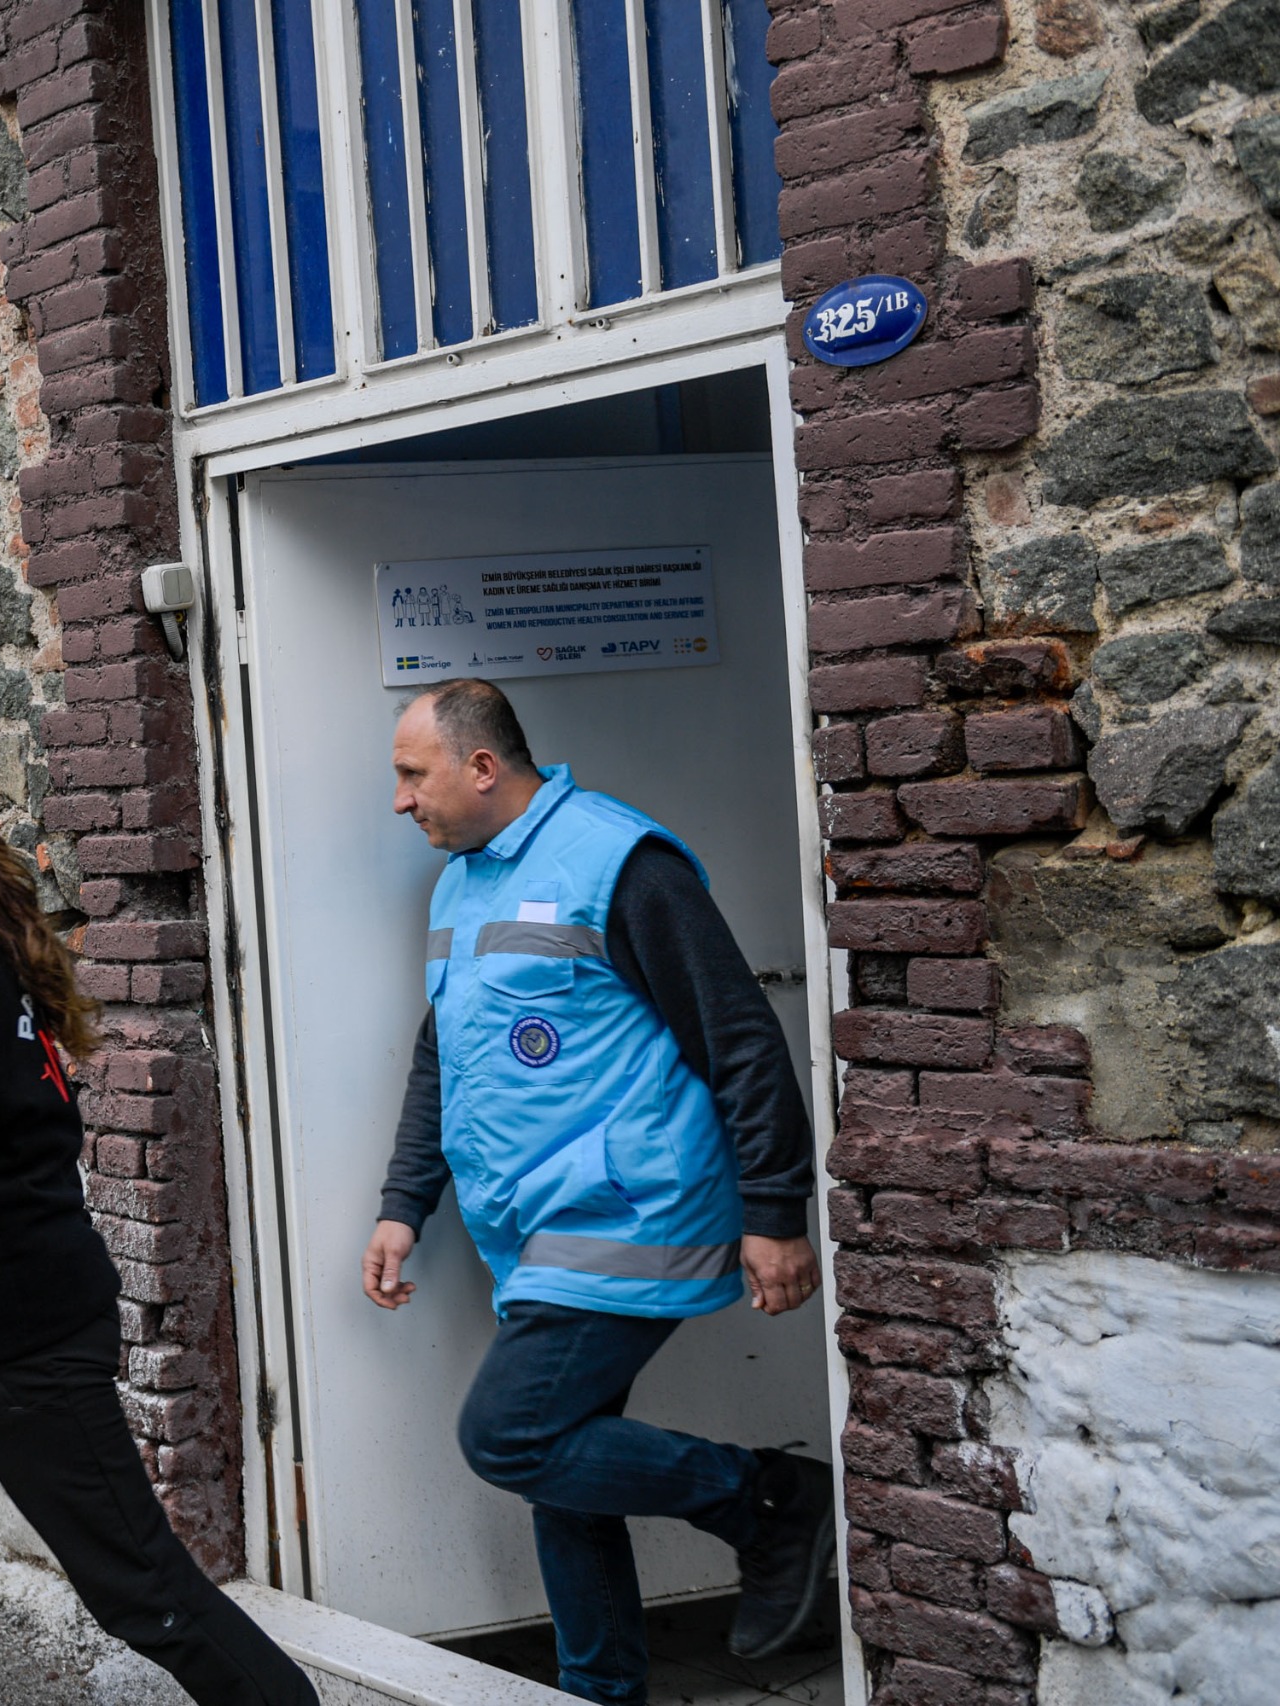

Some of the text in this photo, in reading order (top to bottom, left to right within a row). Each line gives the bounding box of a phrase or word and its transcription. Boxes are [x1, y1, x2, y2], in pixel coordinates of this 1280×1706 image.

[481, 572, 502, 582] İZMİR
[503, 569, 547, 581] BÜYÜKŞEHİR
[548, 566, 587, 578] BELEDİYESİ
[588, 565, 612, 576] SAĞLIK
[613, 564, 635, 576] İŞLERİ
[483, 586, 505, 596] KADIN
[506, 586, 516, 595] VE
[516, 584, 541, 595] ÜREME
[541, 581, 569, 593] SAĞLIĞI
[570, 581, 602, 592] DANIŞMA
[602, 580, 612, 590] VE
[612, 578, 638, 589] HİZMET
[505, 605, 555, 616] METROPOLITAN
[601, 599, 643, 611] DEPARTMENT
[644, 598, 653, 608] OF
[654, 597, 678, 607] HEALTH
[486, 621, 512, 631] WOMEN
[513, 619, 527, 629] AND
[528, 617, 577, 628] REPRODUCTIVE
[577, 615, 602, 626] HEALTH
[649, 611, 664, 621] AND
[555, 644, 586, 654] SAĞLIK
[619, 639, 660, 653] TAPV
[421, 660, 452, 669] Sverige
[556, 652, 582, 661] İŞLERİ
